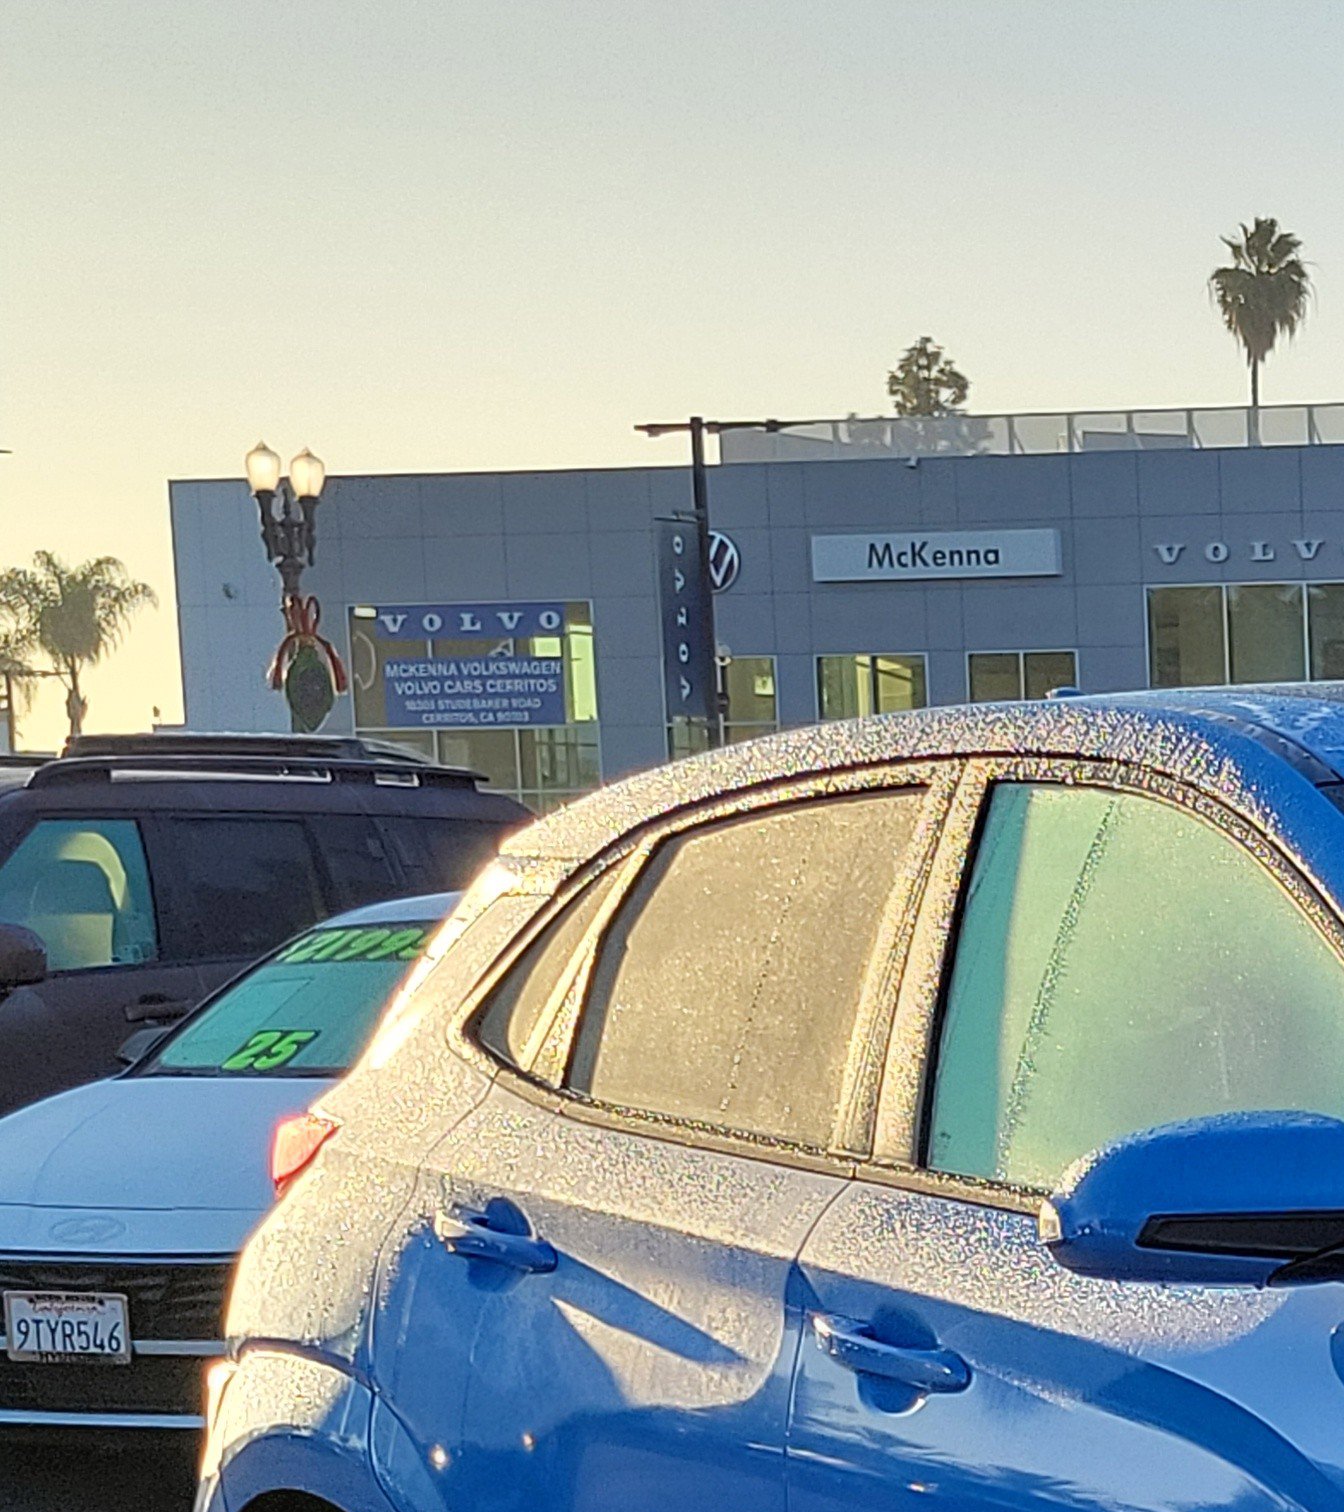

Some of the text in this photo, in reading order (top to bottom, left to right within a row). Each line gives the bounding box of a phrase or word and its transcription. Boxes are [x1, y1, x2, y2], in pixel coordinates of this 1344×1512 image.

[867, 541, 1000, 569] McKenna
[380, 610, 561, 633] VOLVO
[672, 535, 691, 701] VOLVO
[385, 661, 561, 678] MCKENNA VOLKSWAGEN
[394, 678, 557, 695] VOLVO CARS CERRITOS
[480, 712, 496, 722] CA
[222, 1031, 316, 1071] 25
[16, 1317, 121, 1353] 9TYR546
